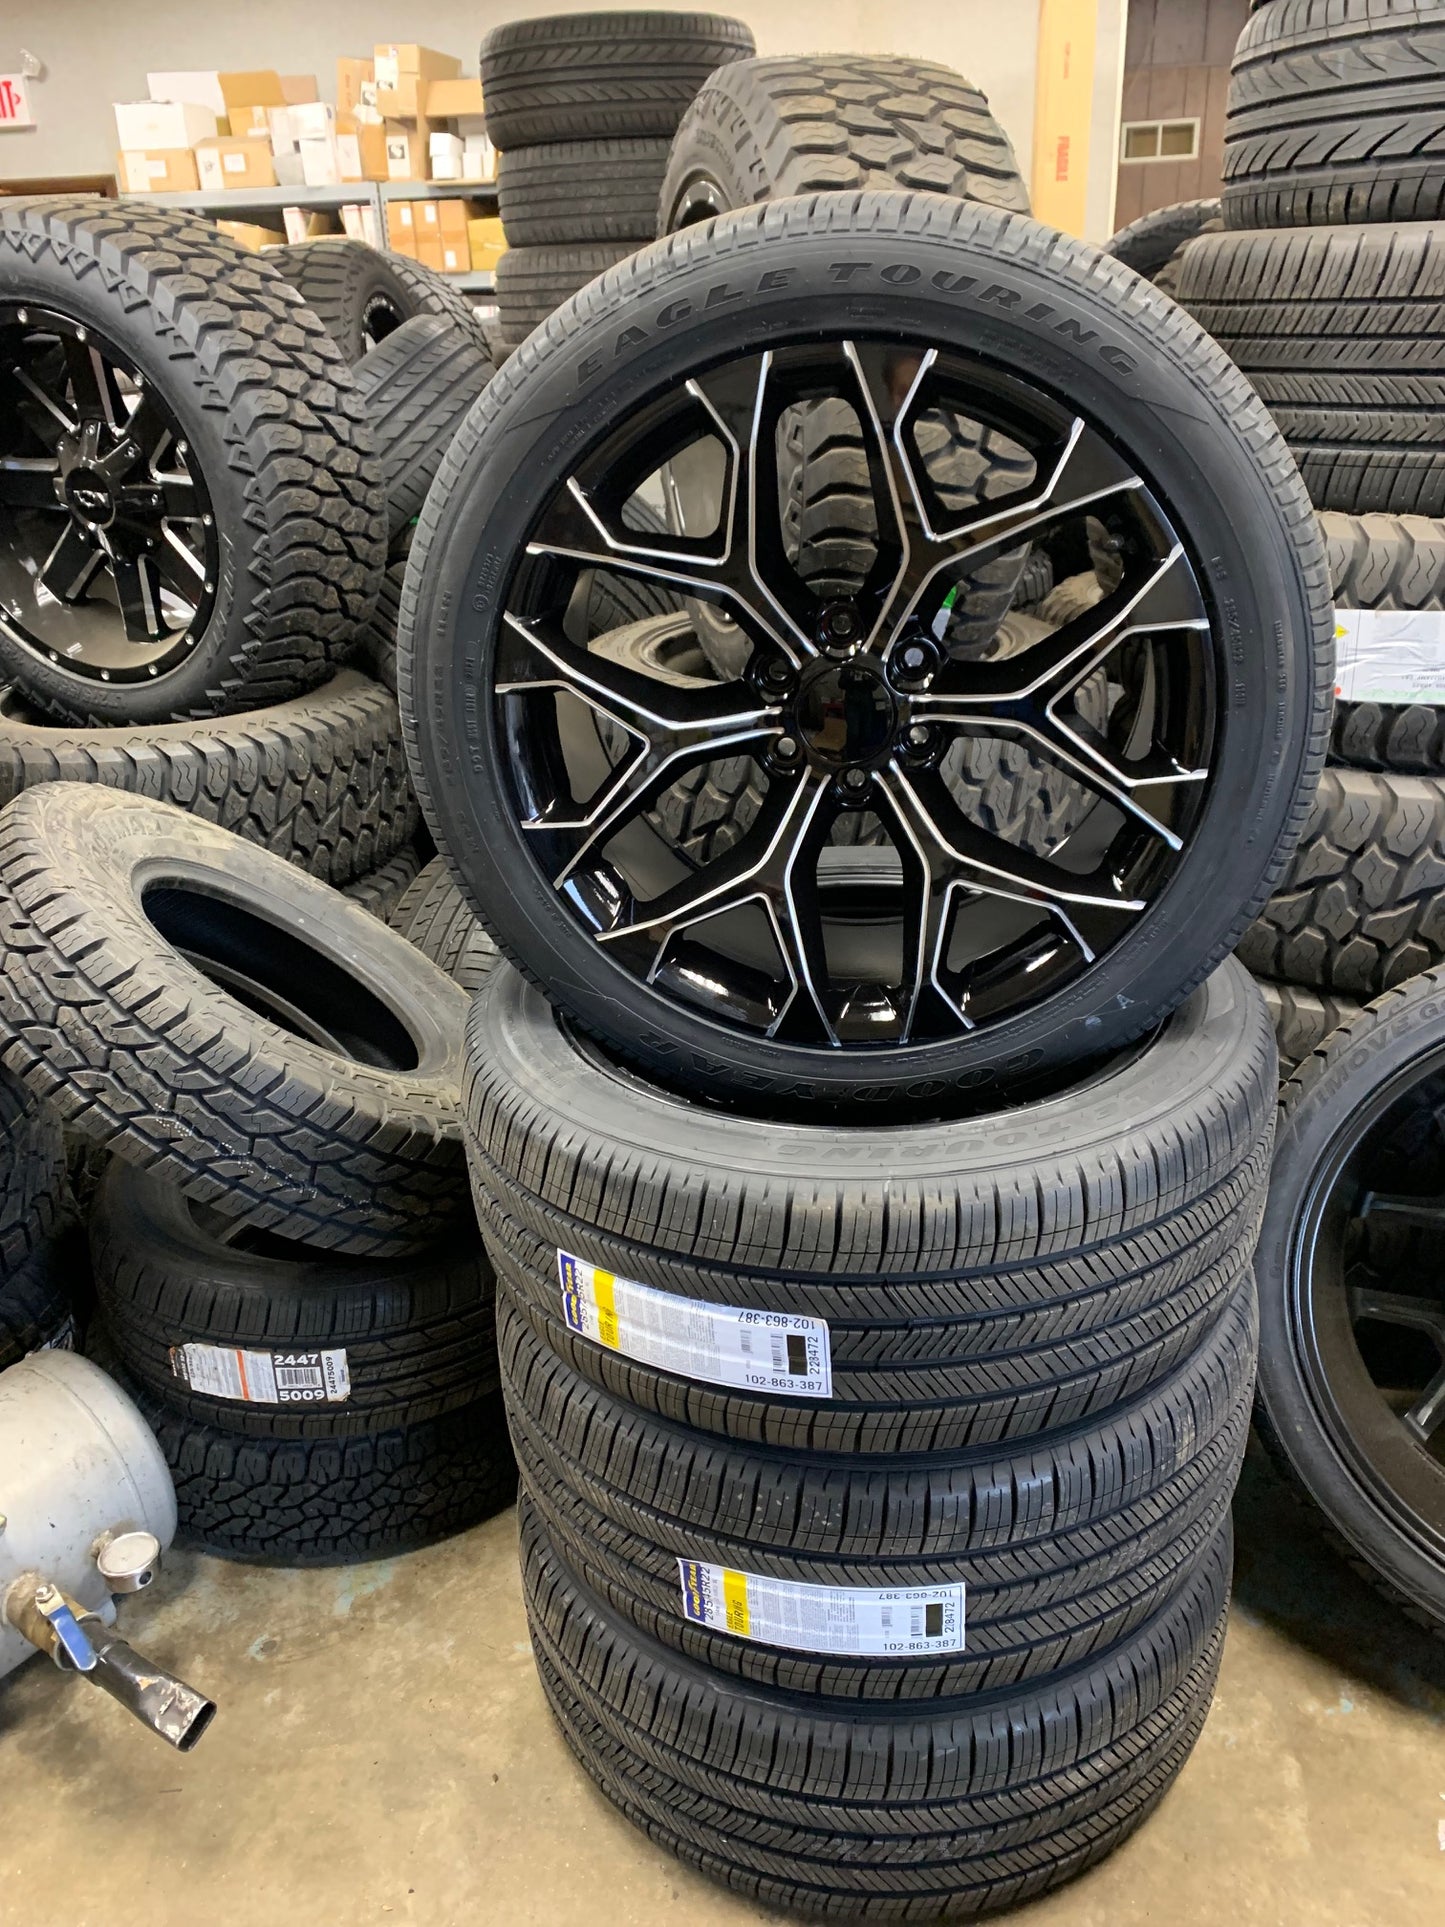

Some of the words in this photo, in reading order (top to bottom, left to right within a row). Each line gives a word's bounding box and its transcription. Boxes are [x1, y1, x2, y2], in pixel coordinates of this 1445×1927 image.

[0, 80, 15, 118] IT
[576, 266, 798, 388] EAGLE
[827, 260, 1140, 379] TOURING
[738, 1310, 816, 1331] 102-863-387
[274, 1354, 319, 1366] 2447
[808, 1336, 821, 1375] 228472
[327, 1356, 338, 1394] 24475009
[744, 1373, 824, 1392] 102-863-387
[279, 1390, 326, 1401] 5009
[882, 1638, 957, 1651] 102-863-387
